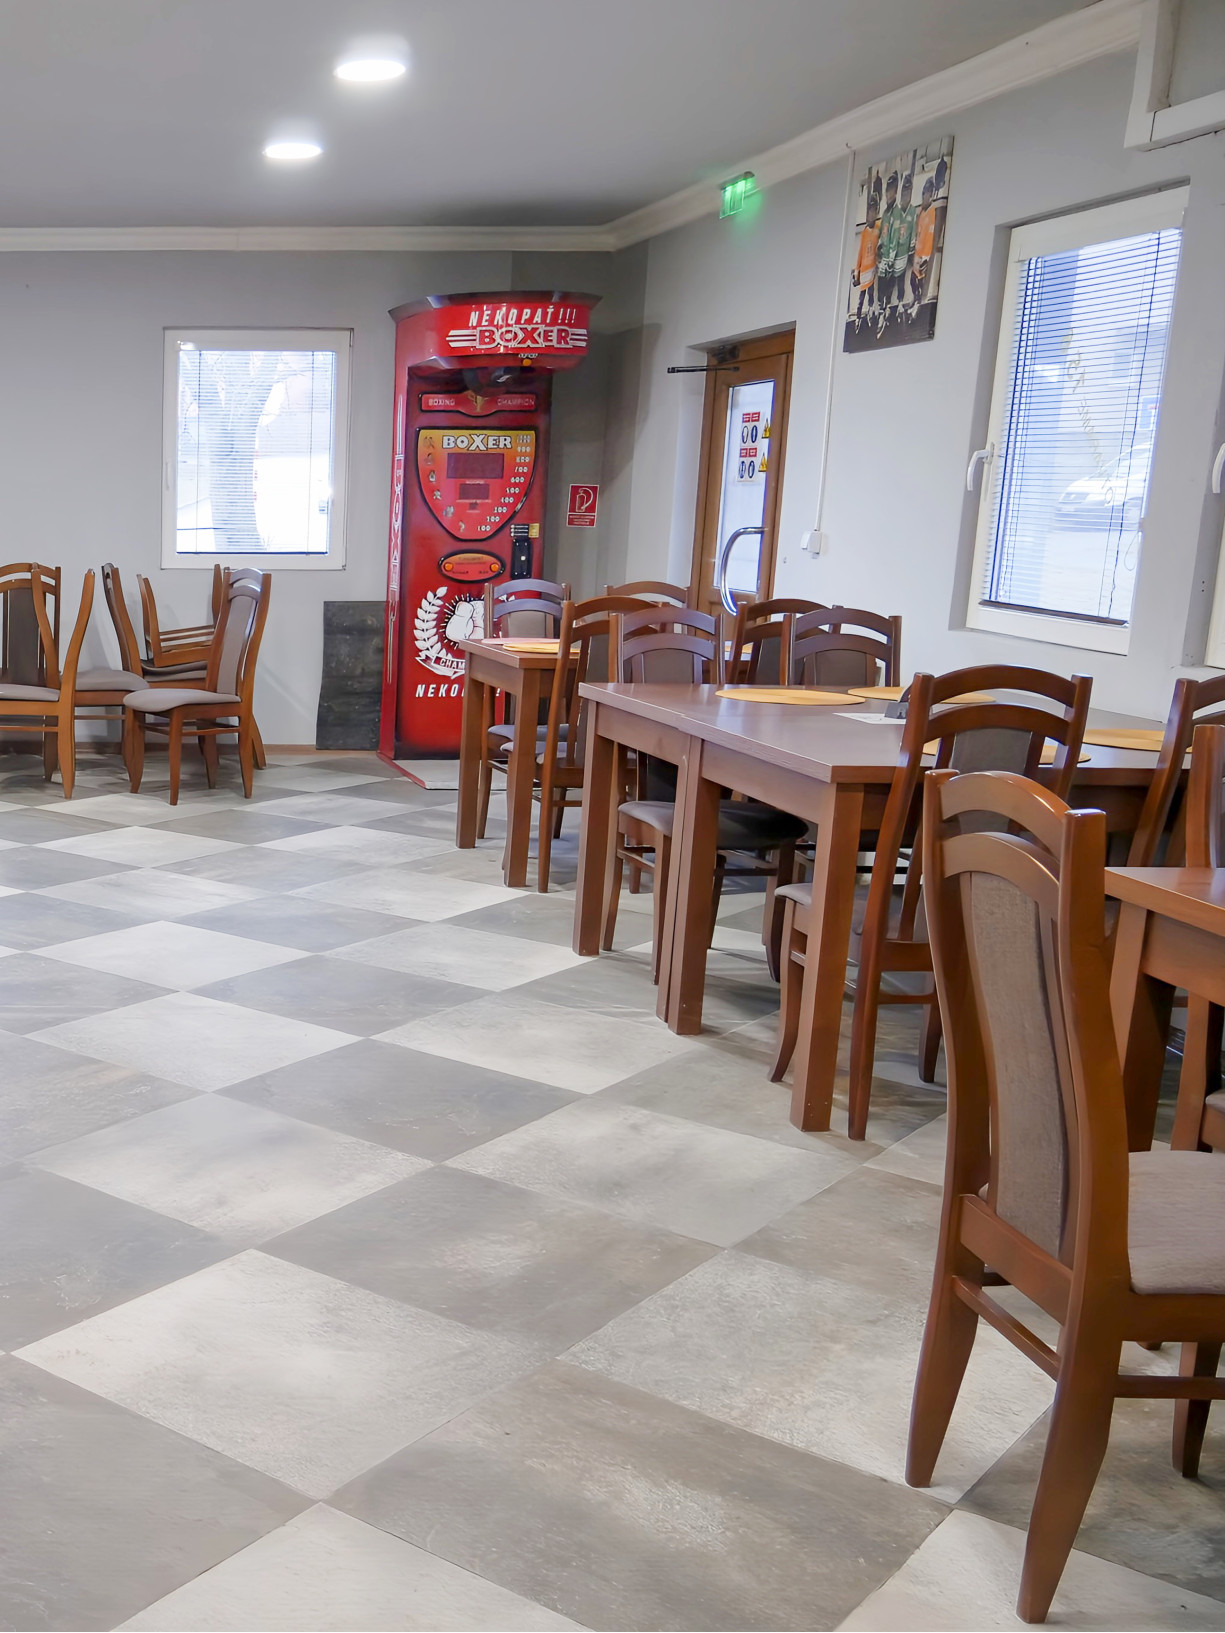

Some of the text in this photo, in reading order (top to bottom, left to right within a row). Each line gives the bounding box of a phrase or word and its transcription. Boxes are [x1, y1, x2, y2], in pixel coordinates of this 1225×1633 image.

[476, 325, 573, 348] BOXER
[428, 398, 535, 406] BOXING CHAMPION
[442, 434, 512, 451] BOXER
[439, 658, 466, 669] CHAM
